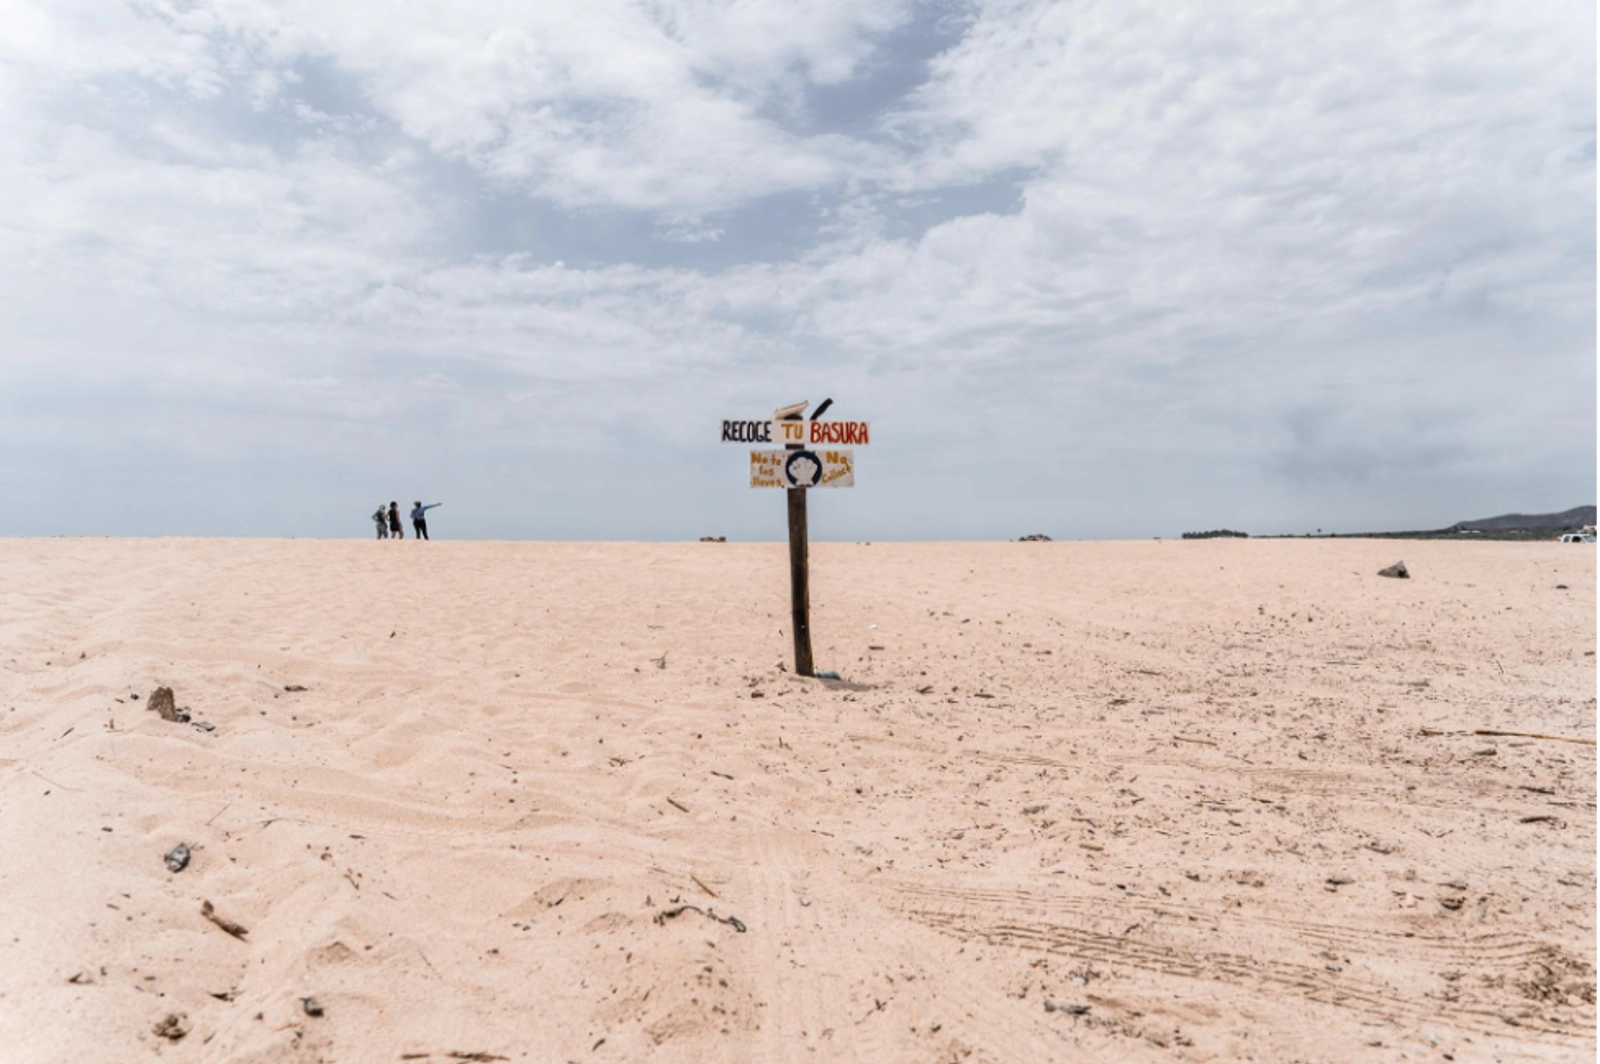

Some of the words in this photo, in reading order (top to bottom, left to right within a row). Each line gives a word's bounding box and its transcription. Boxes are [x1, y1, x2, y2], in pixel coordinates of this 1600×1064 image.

[722, 420, 772, 442] RECOGE
[781, 423, 803, 440] TU
[810, 421, 869, 444] BASURA
[751, 452, 768, 464] No
[826, 451, 847, 465] No
